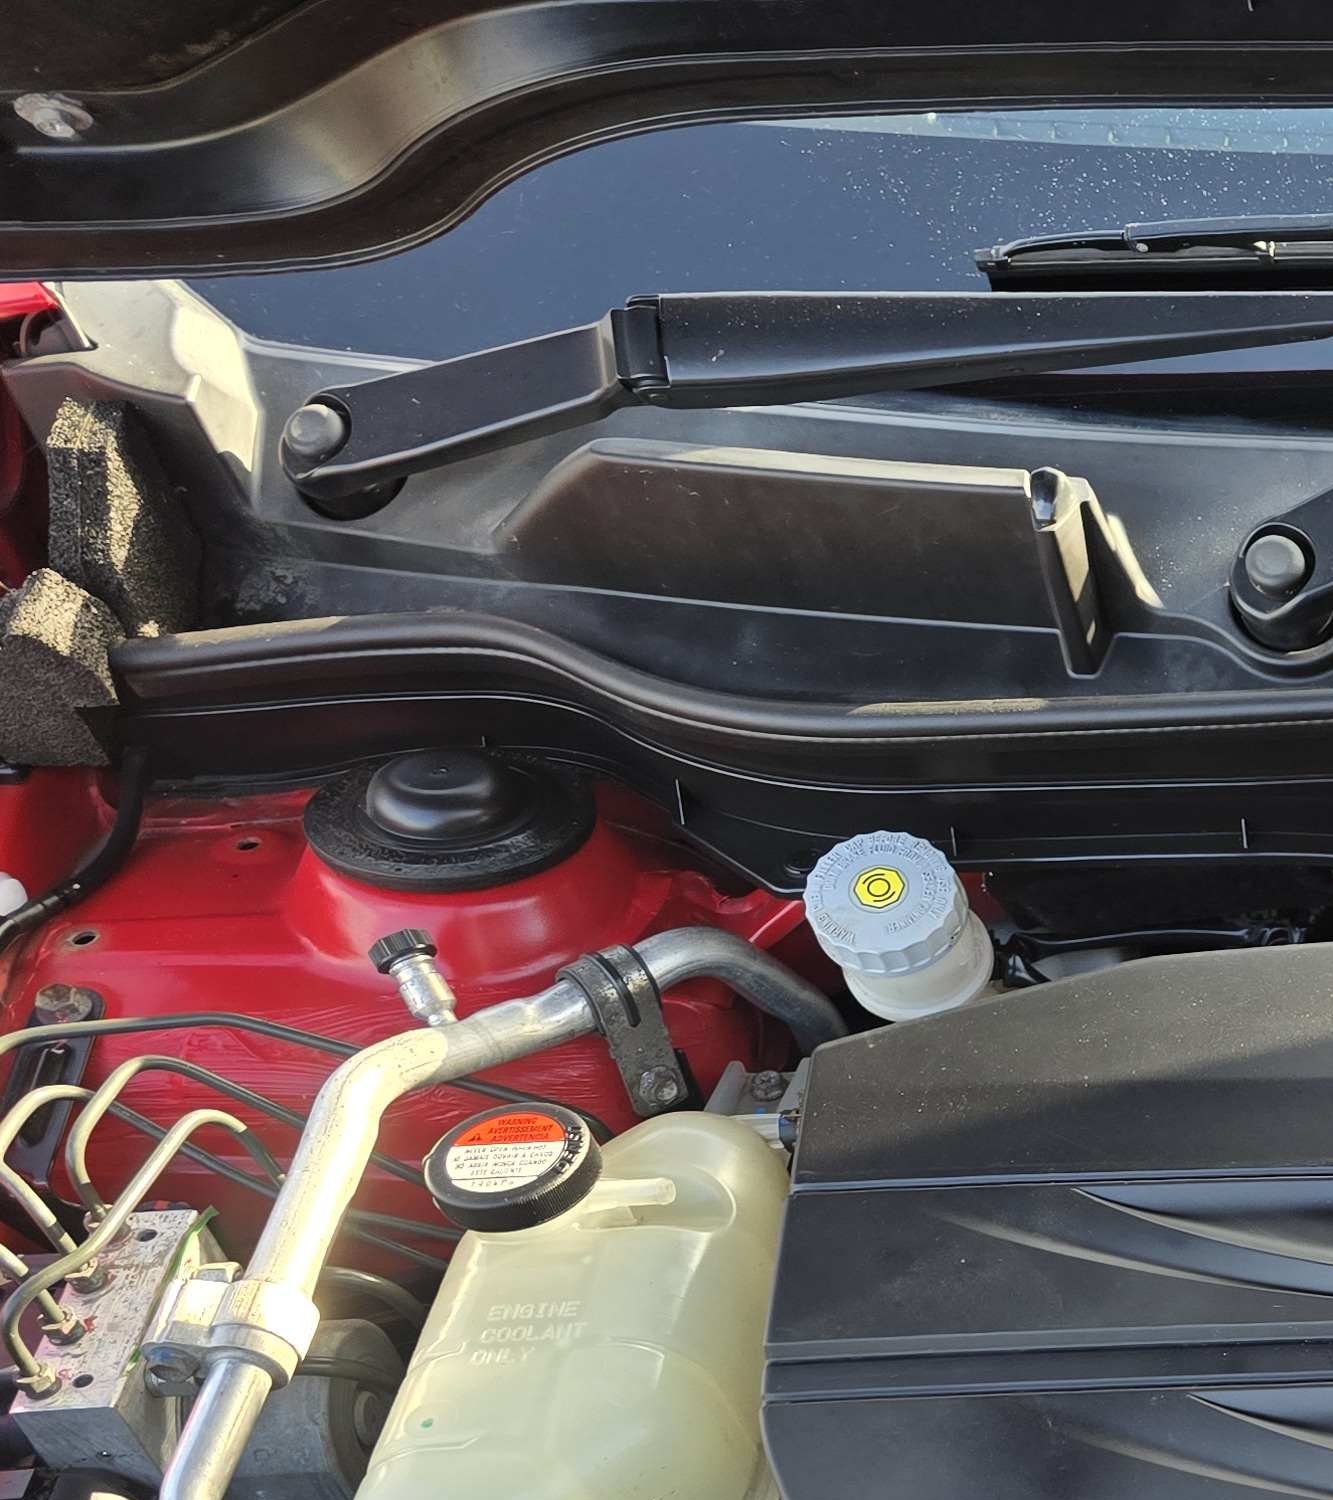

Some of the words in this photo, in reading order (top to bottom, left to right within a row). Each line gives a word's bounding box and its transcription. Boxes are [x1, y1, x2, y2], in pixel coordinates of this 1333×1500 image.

[498, 1118, 537, 1126] WARNING
[488, 1125, 553, 1134] AVERTISSEMENT
[490, 1133, 548, 1142] ADVERTENCIA
[487, 1300, 581, 1321] ENGINE
[480, 1321, 588, 1343] COOLANT
[471, 1346, 535, 1365] ONLY
